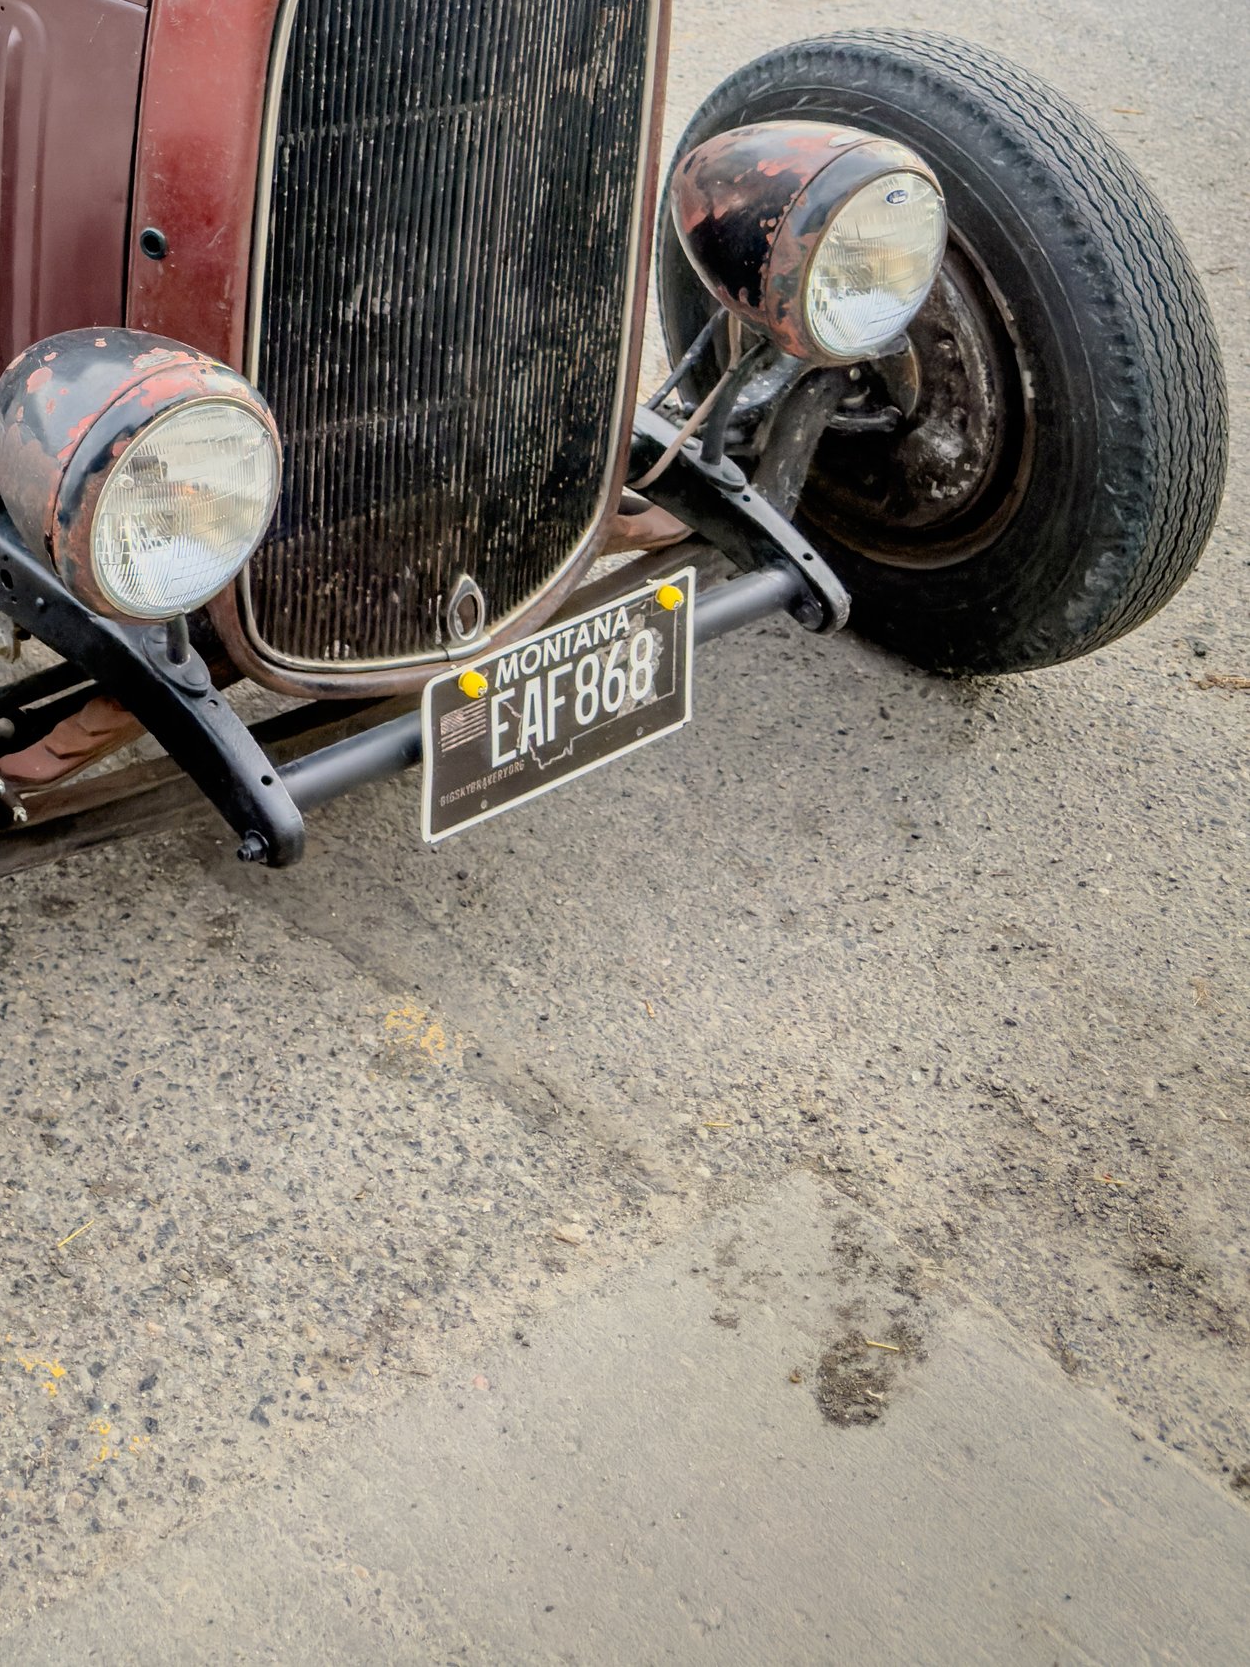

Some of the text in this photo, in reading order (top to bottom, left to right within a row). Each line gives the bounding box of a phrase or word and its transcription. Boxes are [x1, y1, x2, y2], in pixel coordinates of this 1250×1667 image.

[491, 629, 654, 768] EAF 868
[495, 606, 630, 687] MONTANA
